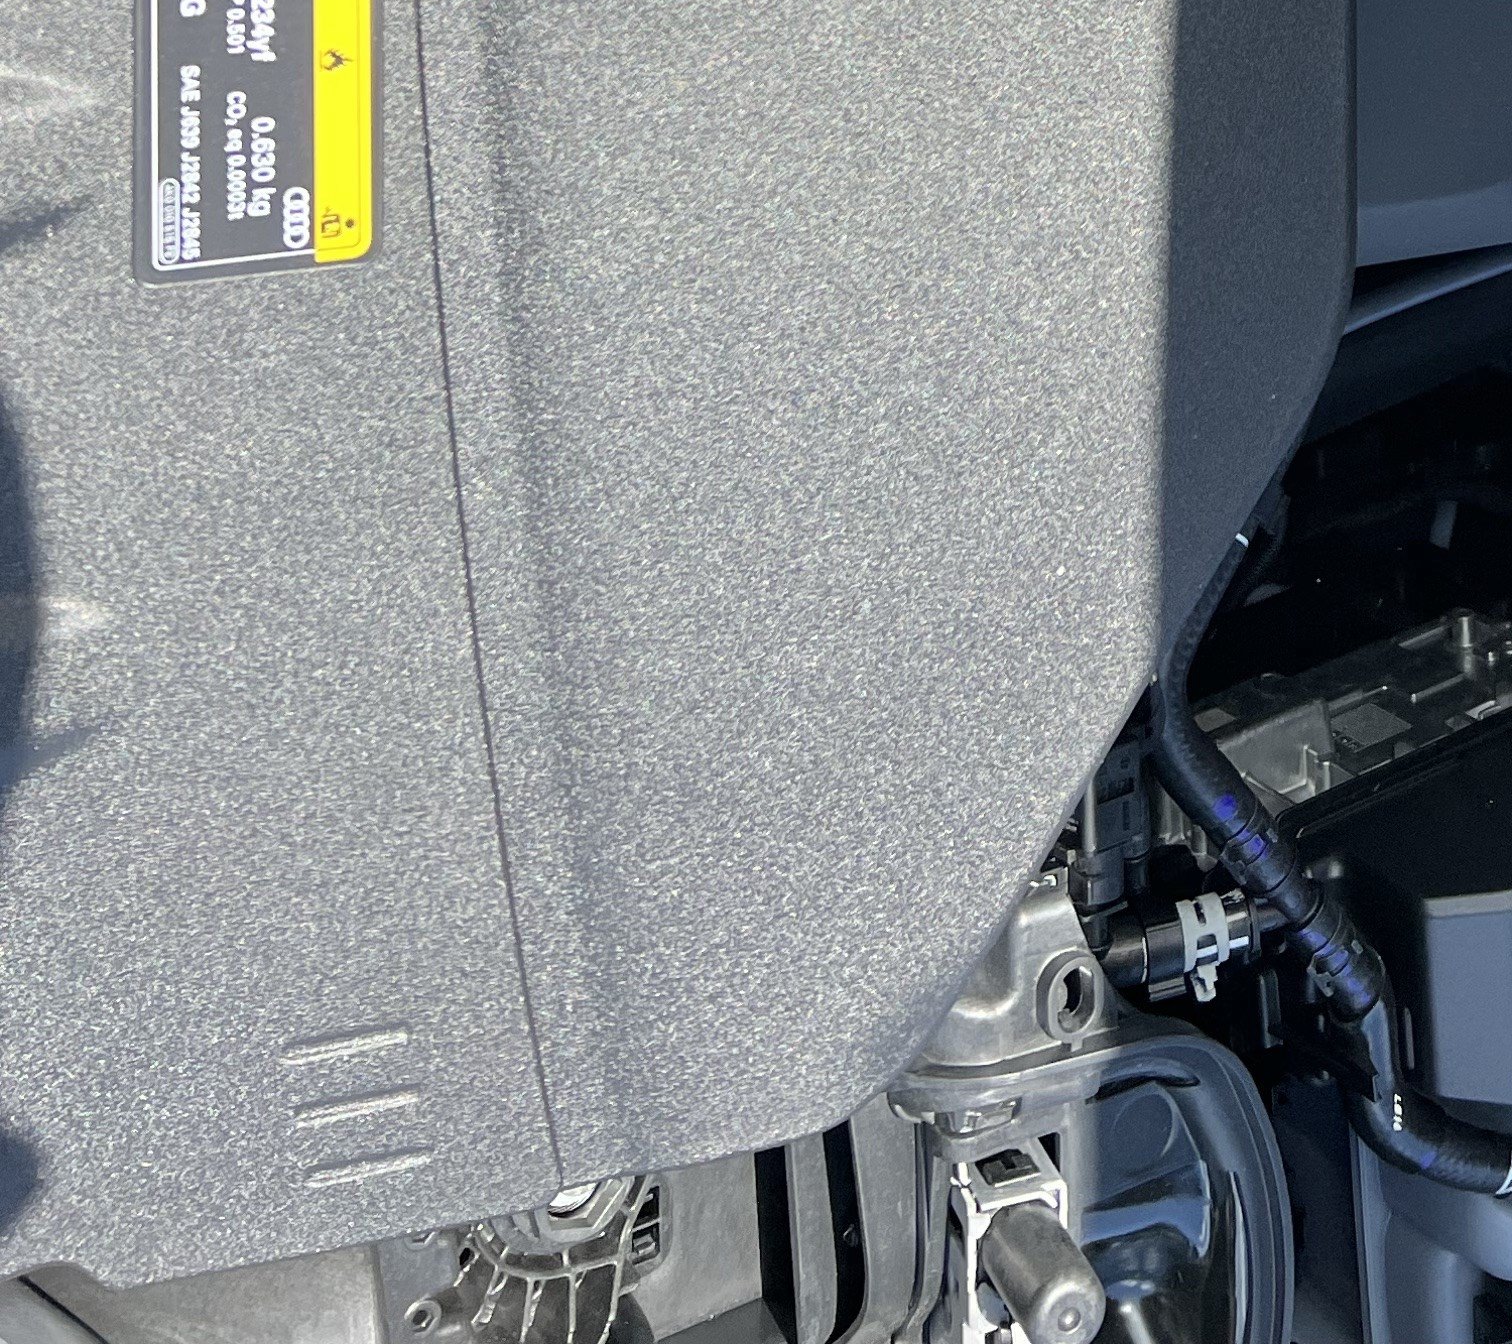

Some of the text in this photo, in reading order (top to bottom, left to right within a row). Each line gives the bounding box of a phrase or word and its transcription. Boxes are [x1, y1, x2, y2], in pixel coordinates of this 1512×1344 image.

[226, 8, 246, 54] 0.501
[181, 64, 202, 103] SAE
[181, 105, 202, 150] J639
[224, 128, 244, 153] eq
[251, 116, 277, 182] 0.630
[181, 151, 202, 204] J2842
[247, 187, 277, 217] kg
